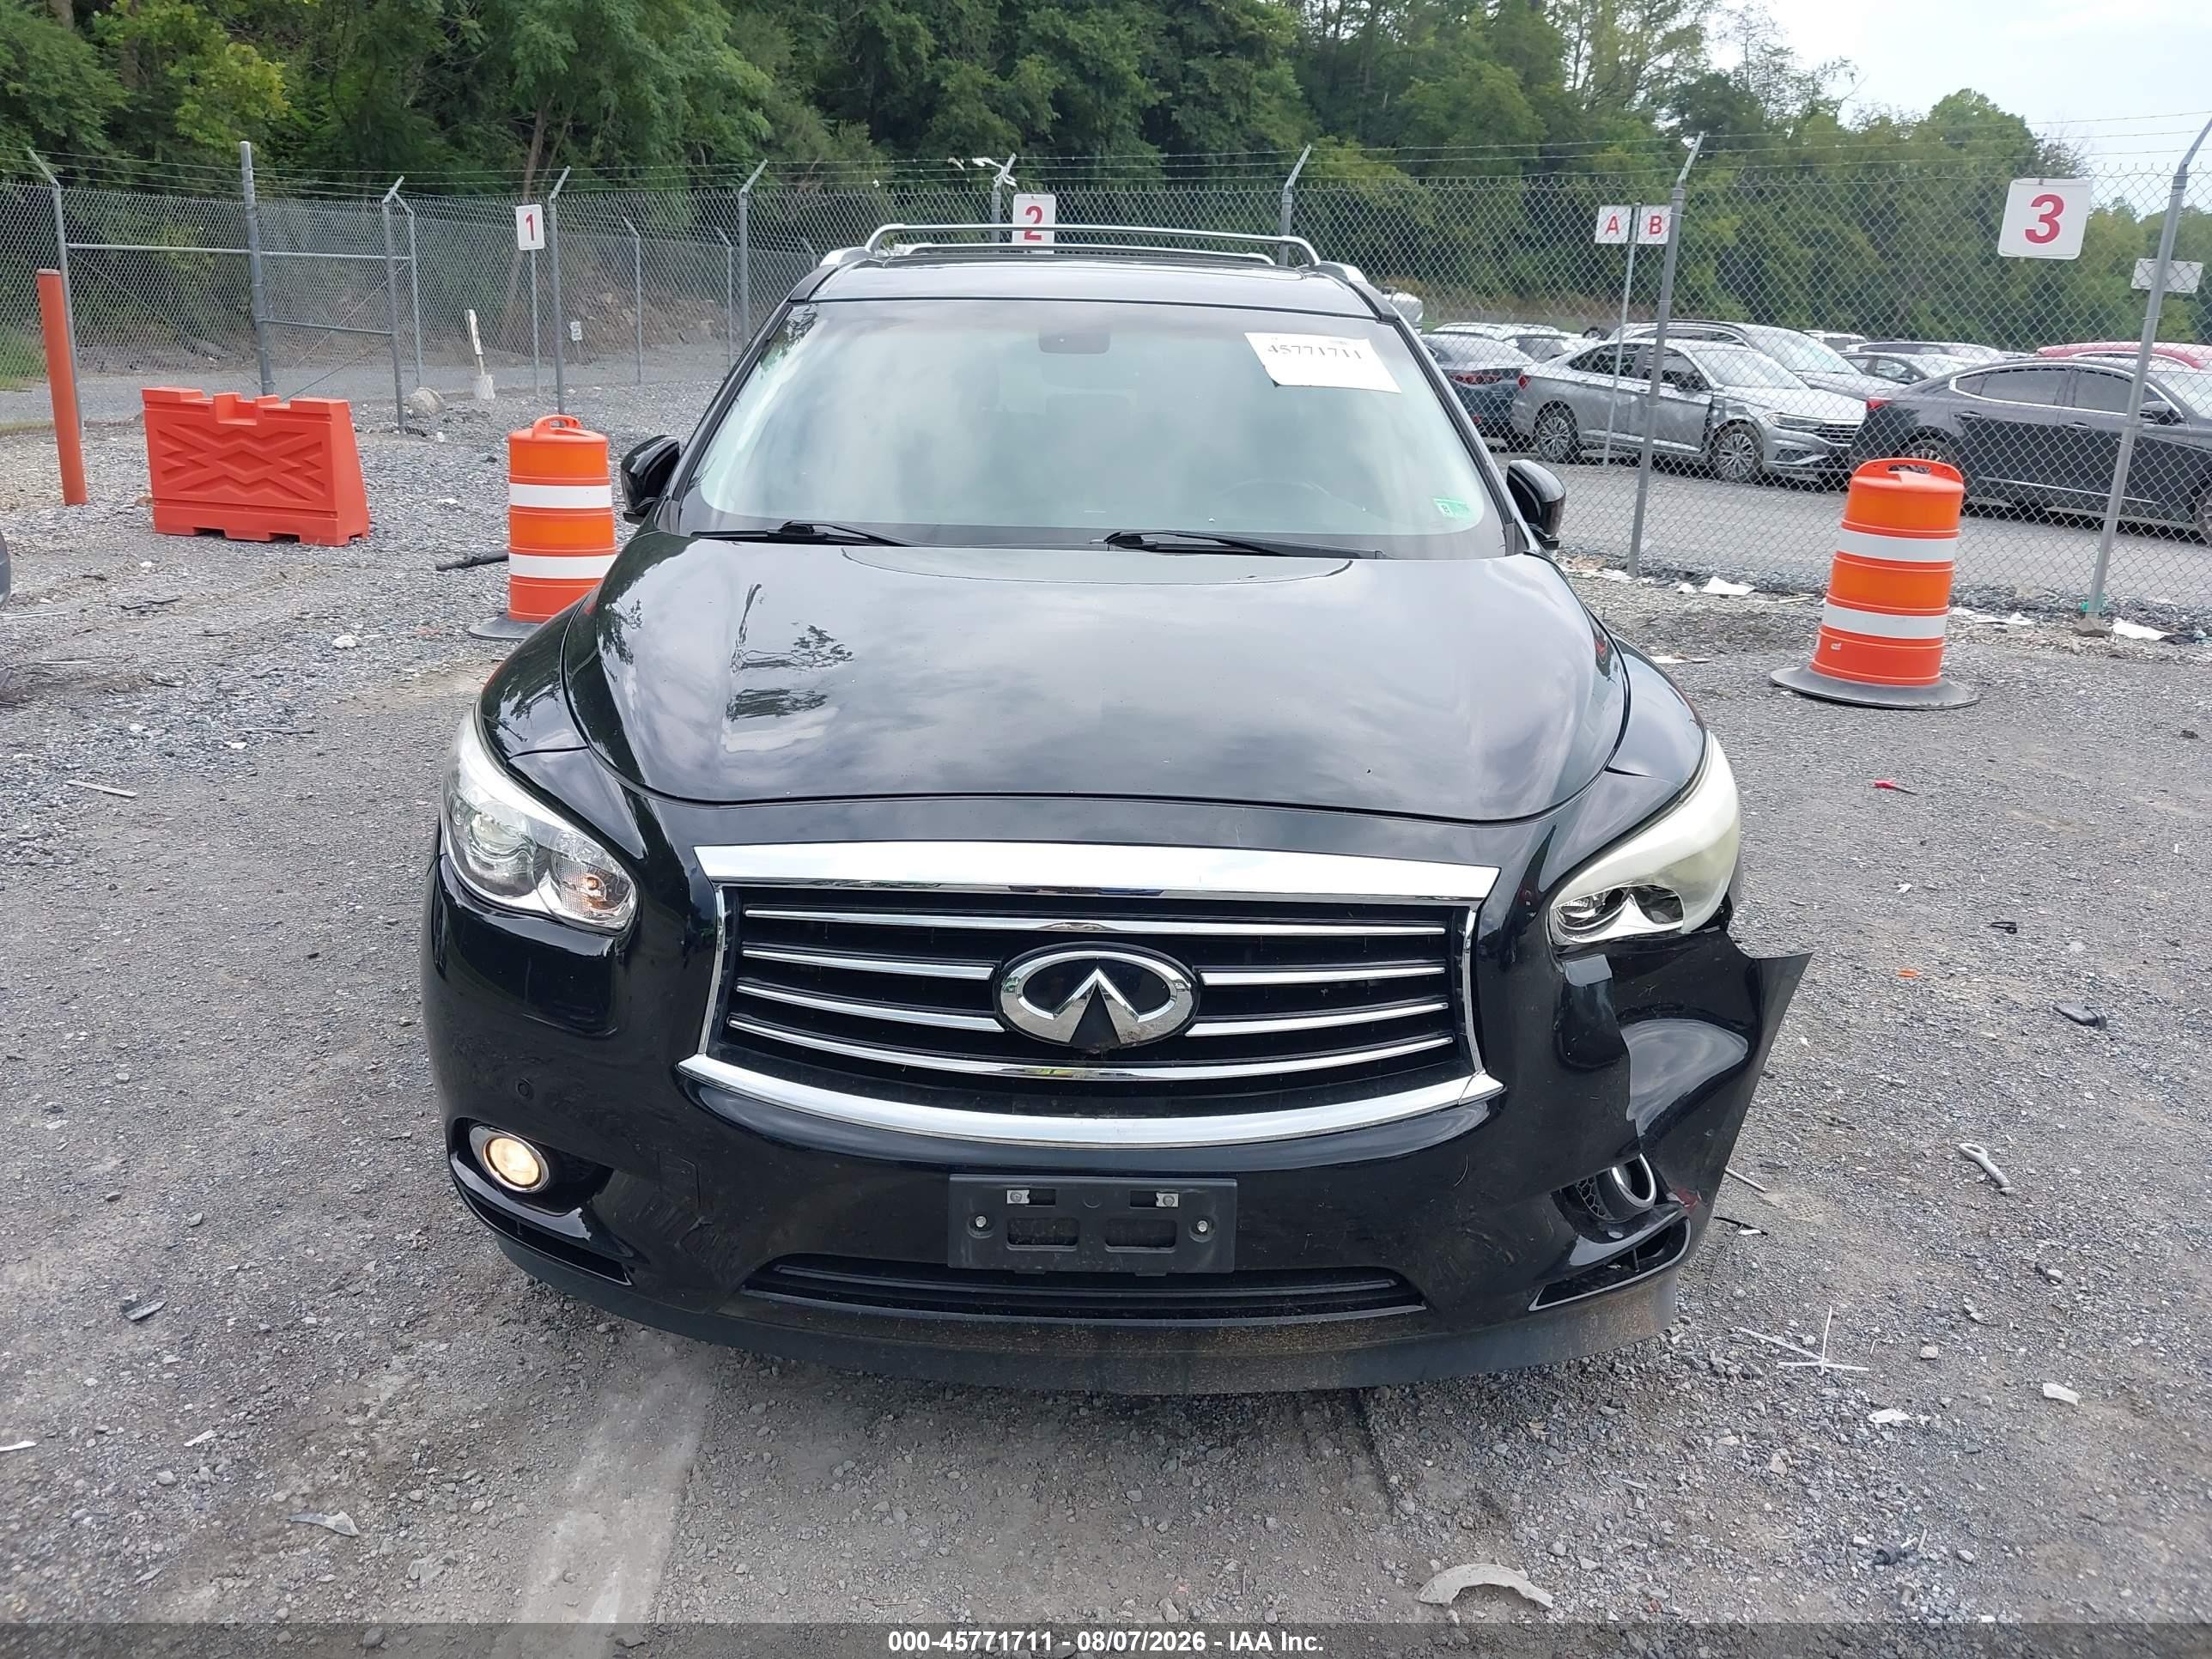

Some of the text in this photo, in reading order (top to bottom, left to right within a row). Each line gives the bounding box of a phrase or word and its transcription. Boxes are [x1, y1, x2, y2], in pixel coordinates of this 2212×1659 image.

[526, 213, 535, 241] 1
[1024, 205, 1042, 240] 2
[1604, 215, 1620, 235] A
[1649, 215, 1662, 235] B
[2024, 193, 2064, 245] 3
[1267, 343, 1363, 360] 45771711
